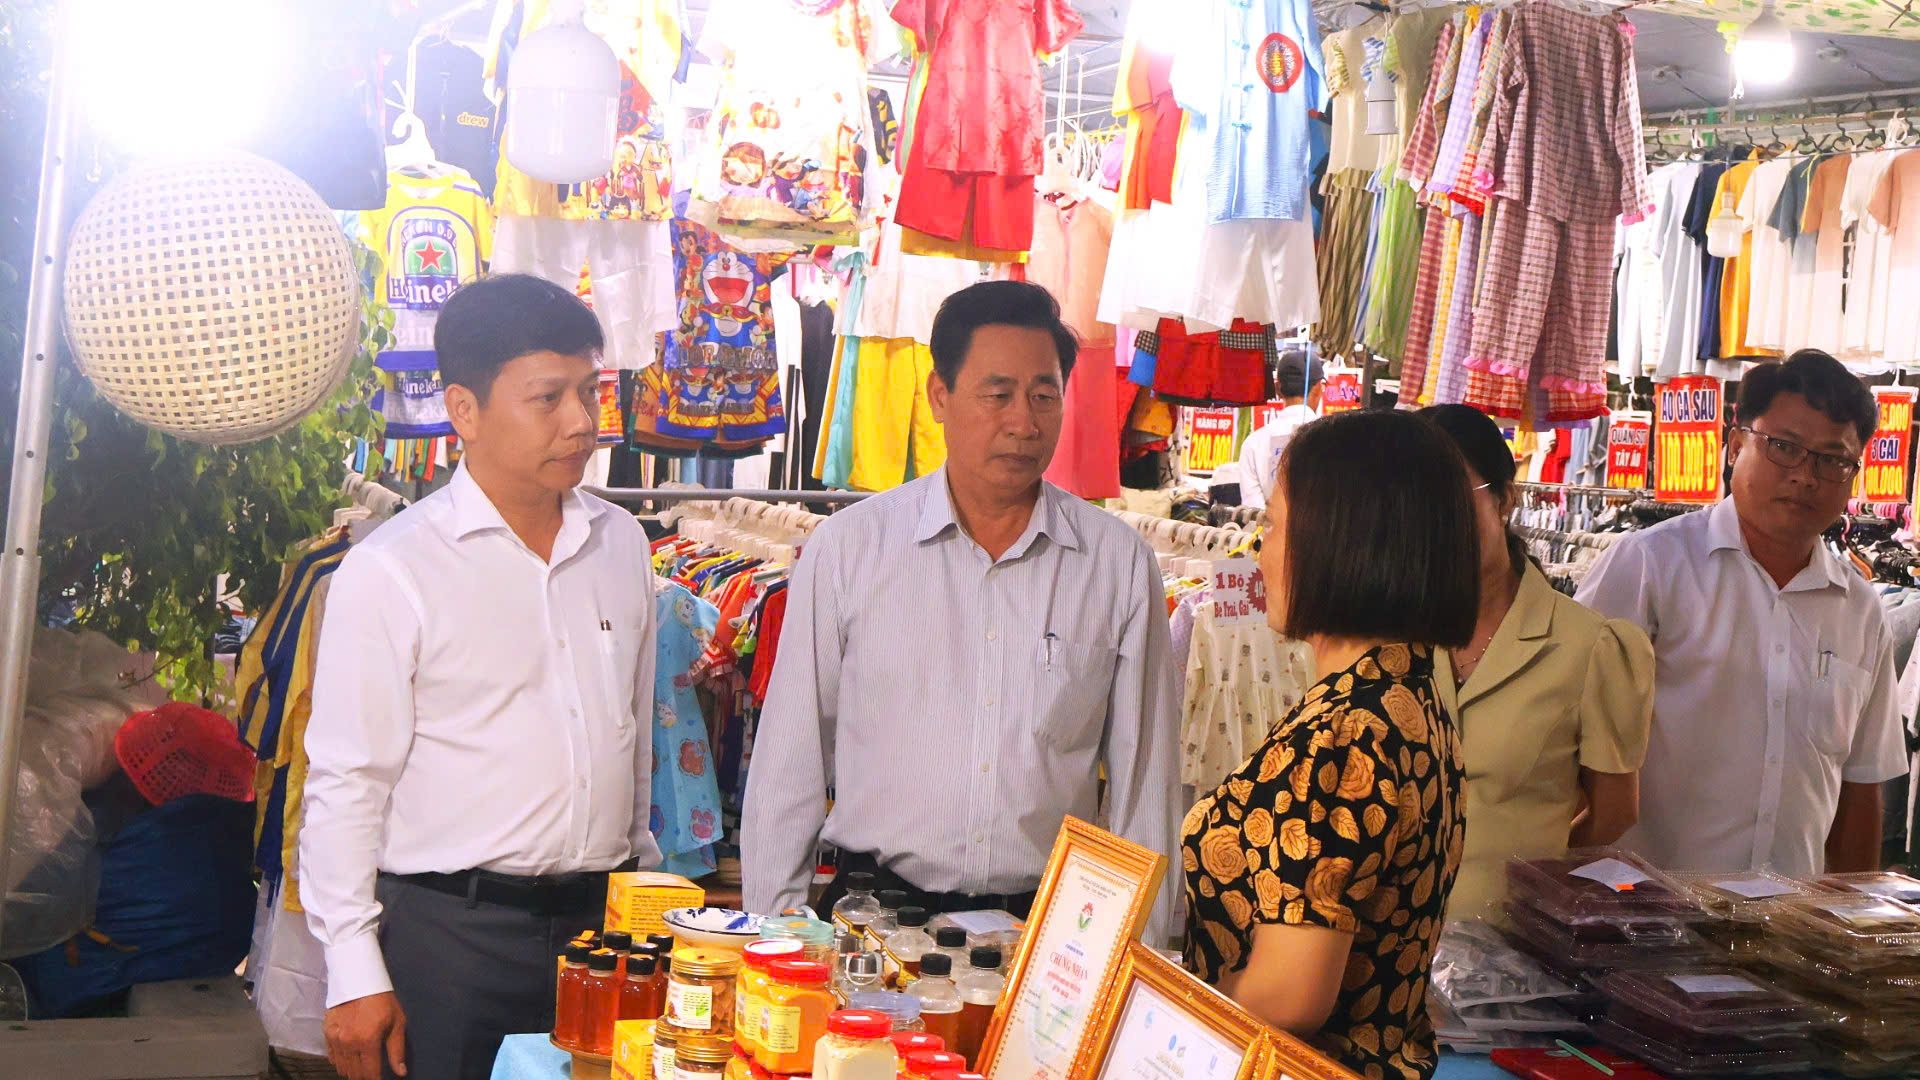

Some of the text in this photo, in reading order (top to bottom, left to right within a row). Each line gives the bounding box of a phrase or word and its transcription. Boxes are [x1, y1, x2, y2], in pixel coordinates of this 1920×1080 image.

[457, 112, 489, 128] drew
[1878, 433, 1900, 461] CÁI
[1660, 431, 1704, 491] 100.000
[1216, 572, 1225, 589] 1
